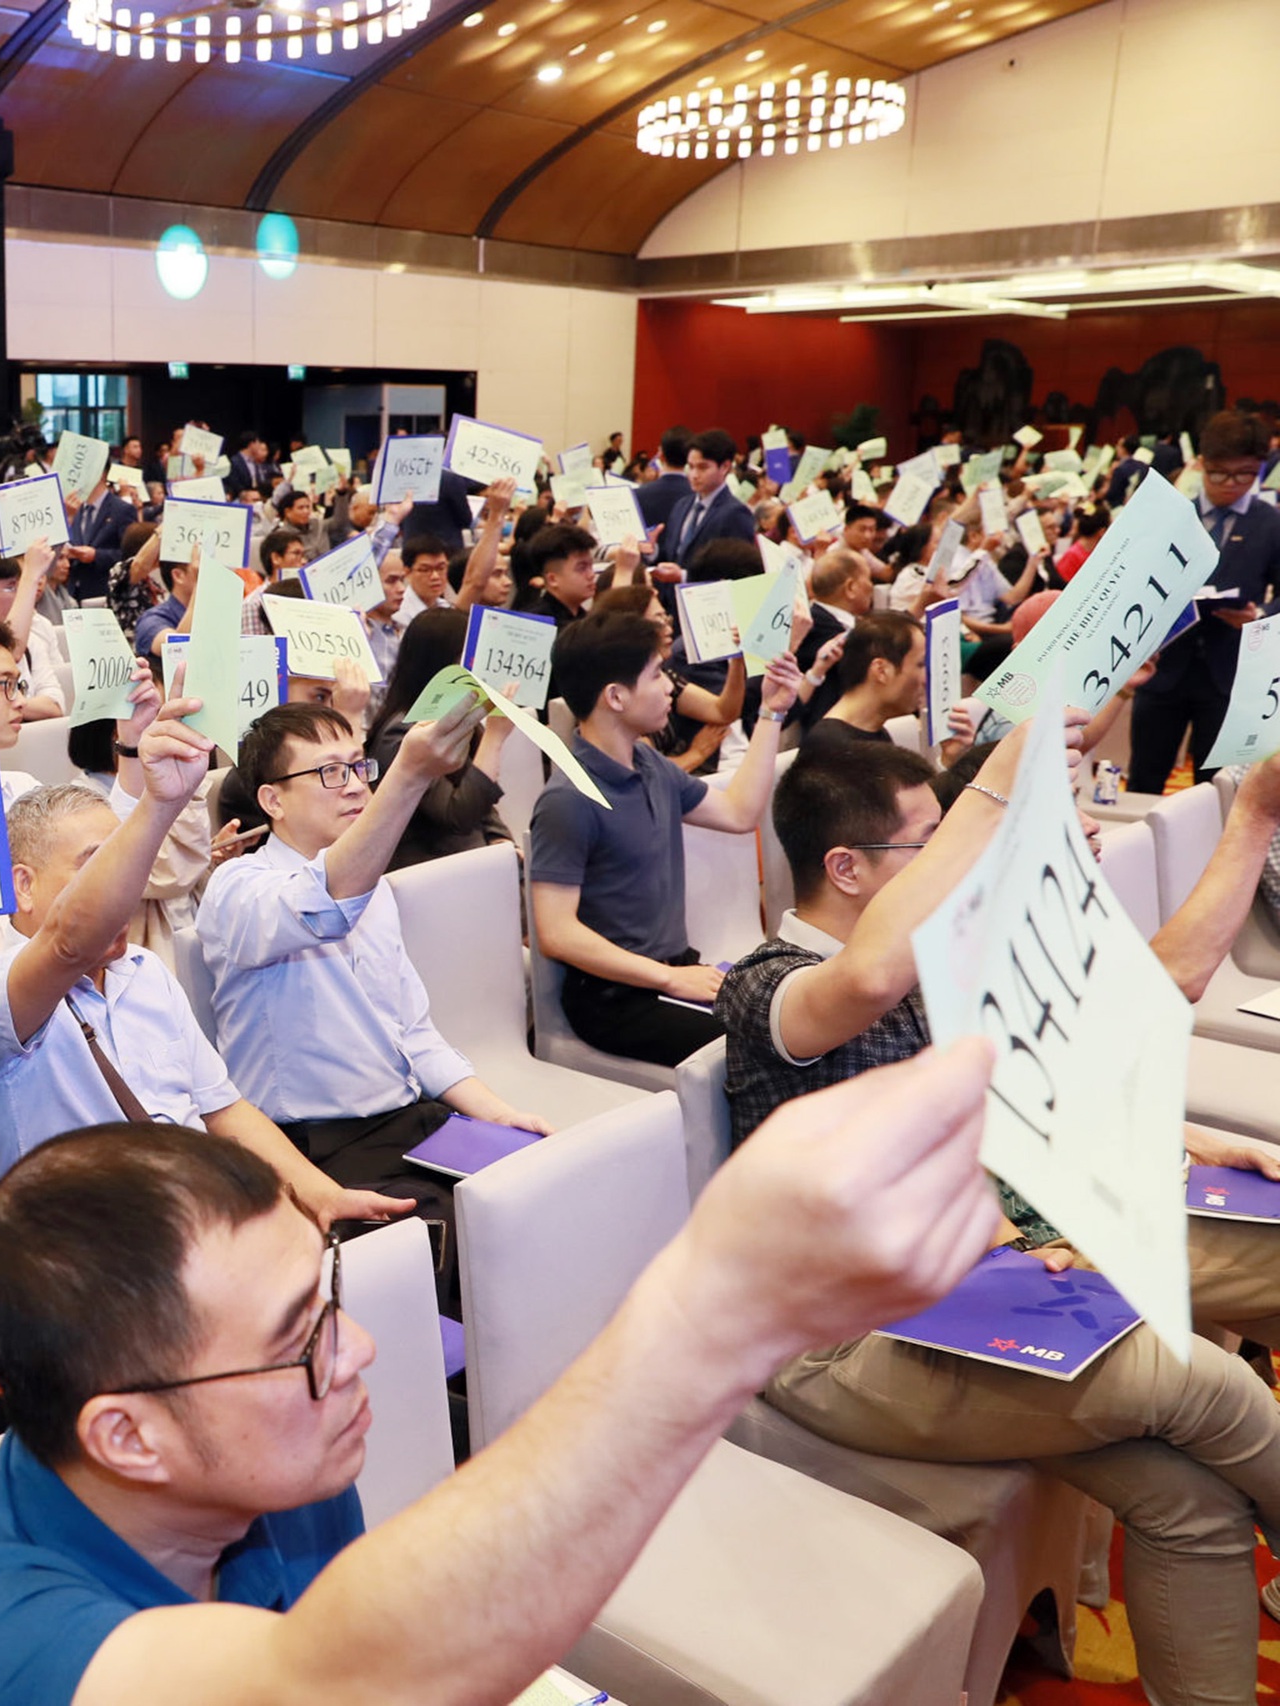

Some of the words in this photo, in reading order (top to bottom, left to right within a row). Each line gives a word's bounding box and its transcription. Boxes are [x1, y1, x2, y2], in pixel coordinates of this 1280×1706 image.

[466, 445, 521, 475] 42586
[11, 506, 55, 534] 87995
[175, 525, 231, 549] 362
[288, 629, 361, 658] 102530
[485, 648, 547, 682] 134364
[997, 671, 1014, 689] MB
[981, 821, 1109, 1149] 134124
[1020, 1345, 1065, 1362] MB
